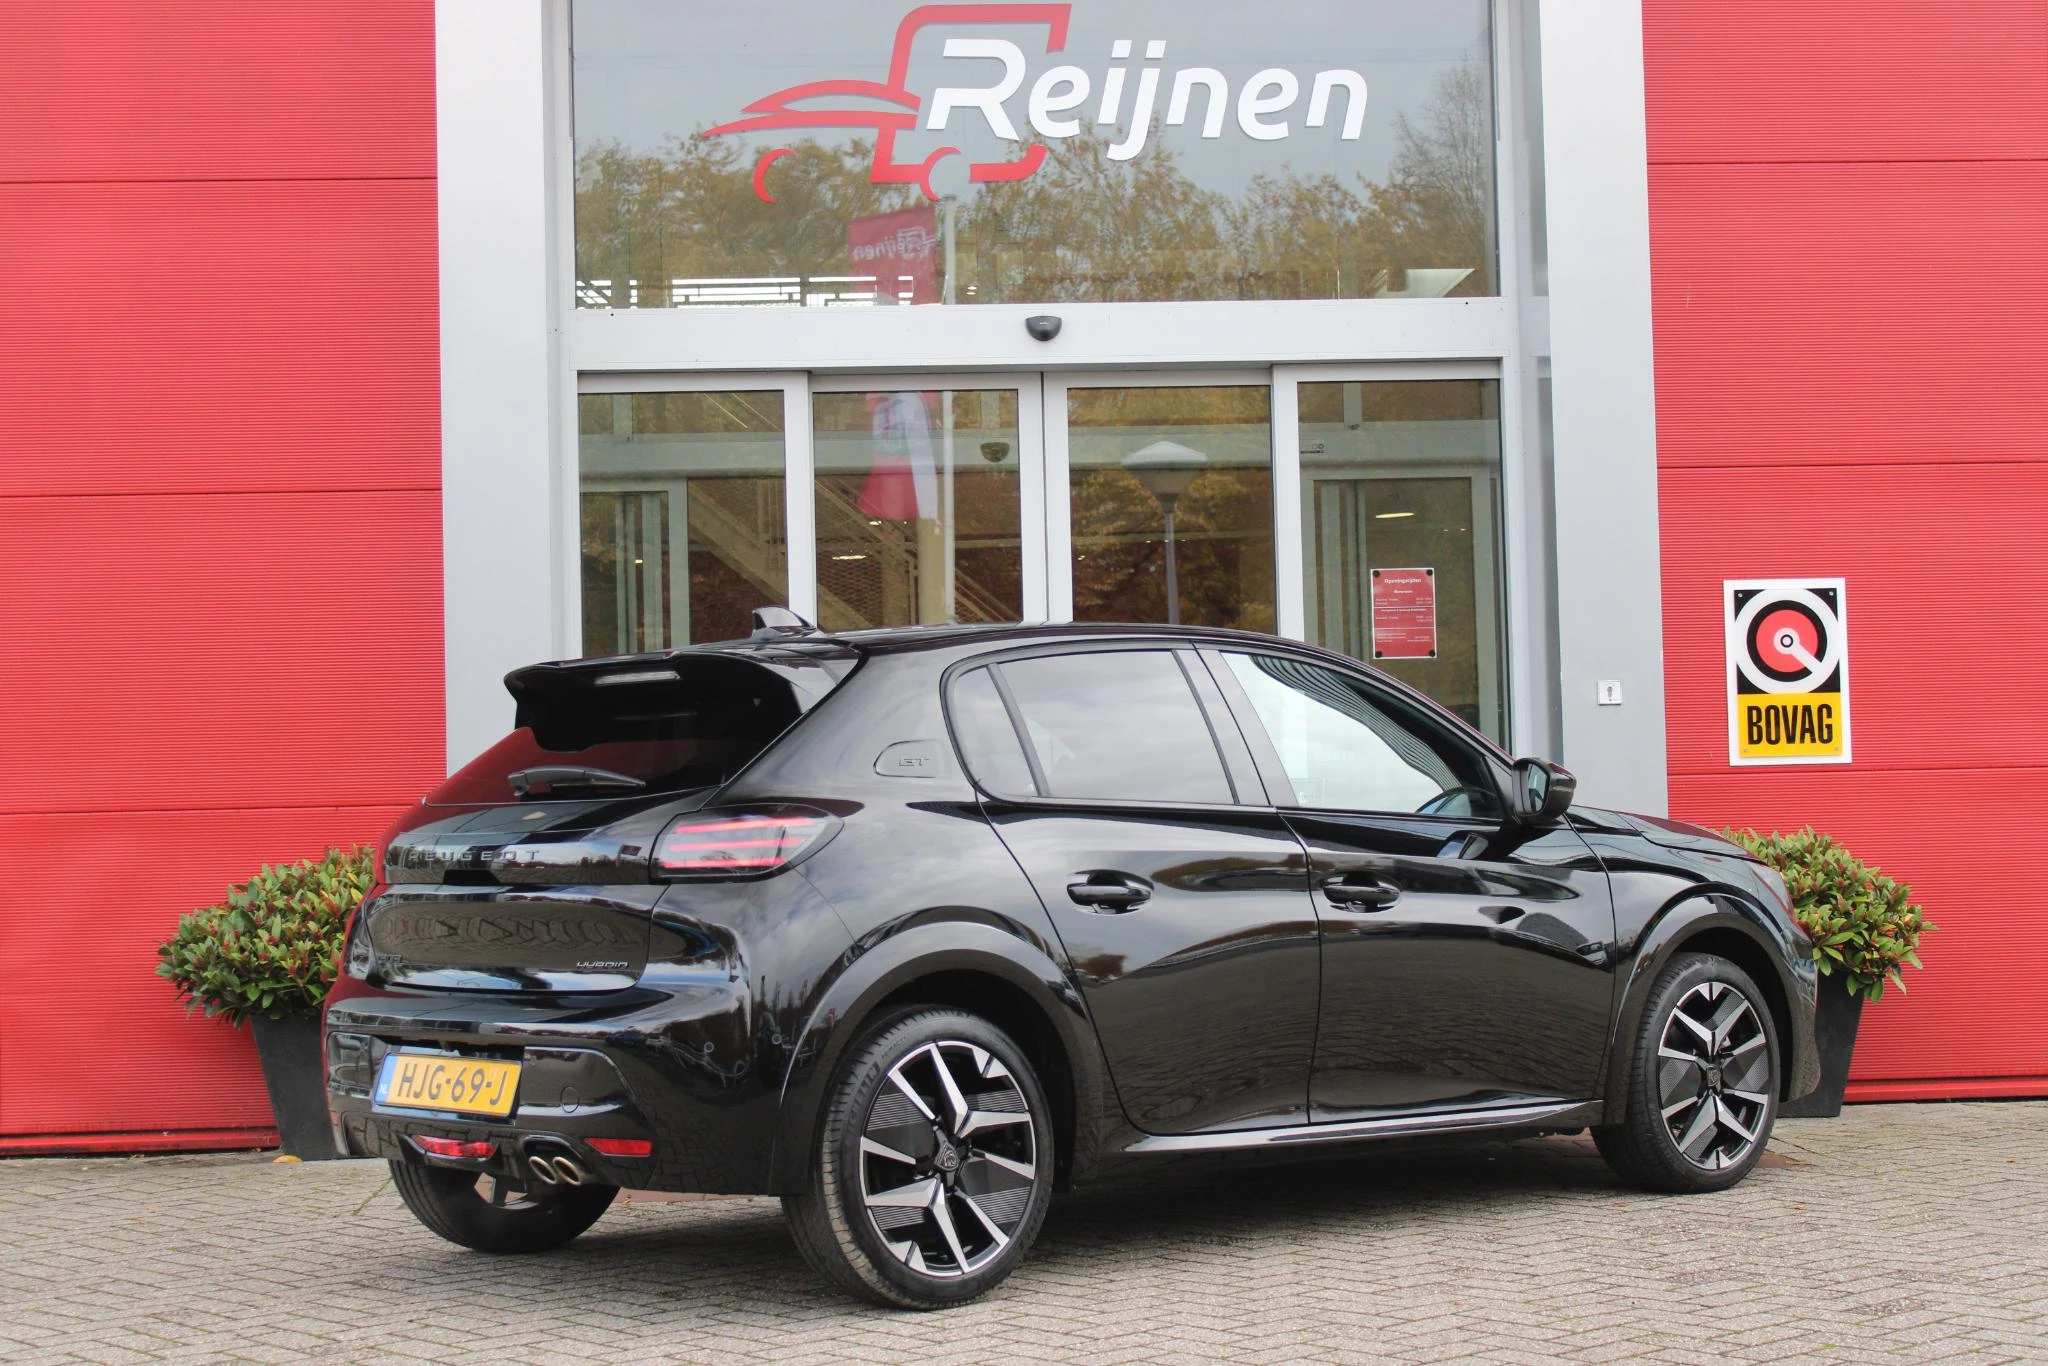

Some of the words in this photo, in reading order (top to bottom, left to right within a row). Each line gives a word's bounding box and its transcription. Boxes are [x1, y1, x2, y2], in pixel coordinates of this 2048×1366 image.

[925, 38, 1369, 162] Reijnen
[1746, 703, 1834, 745] BOVAG
[898, 758, 931, 767] GT
[408, 850, 540, 861] PEUGEOT
[397, 1062, 508, 1106] HJG-69-J
